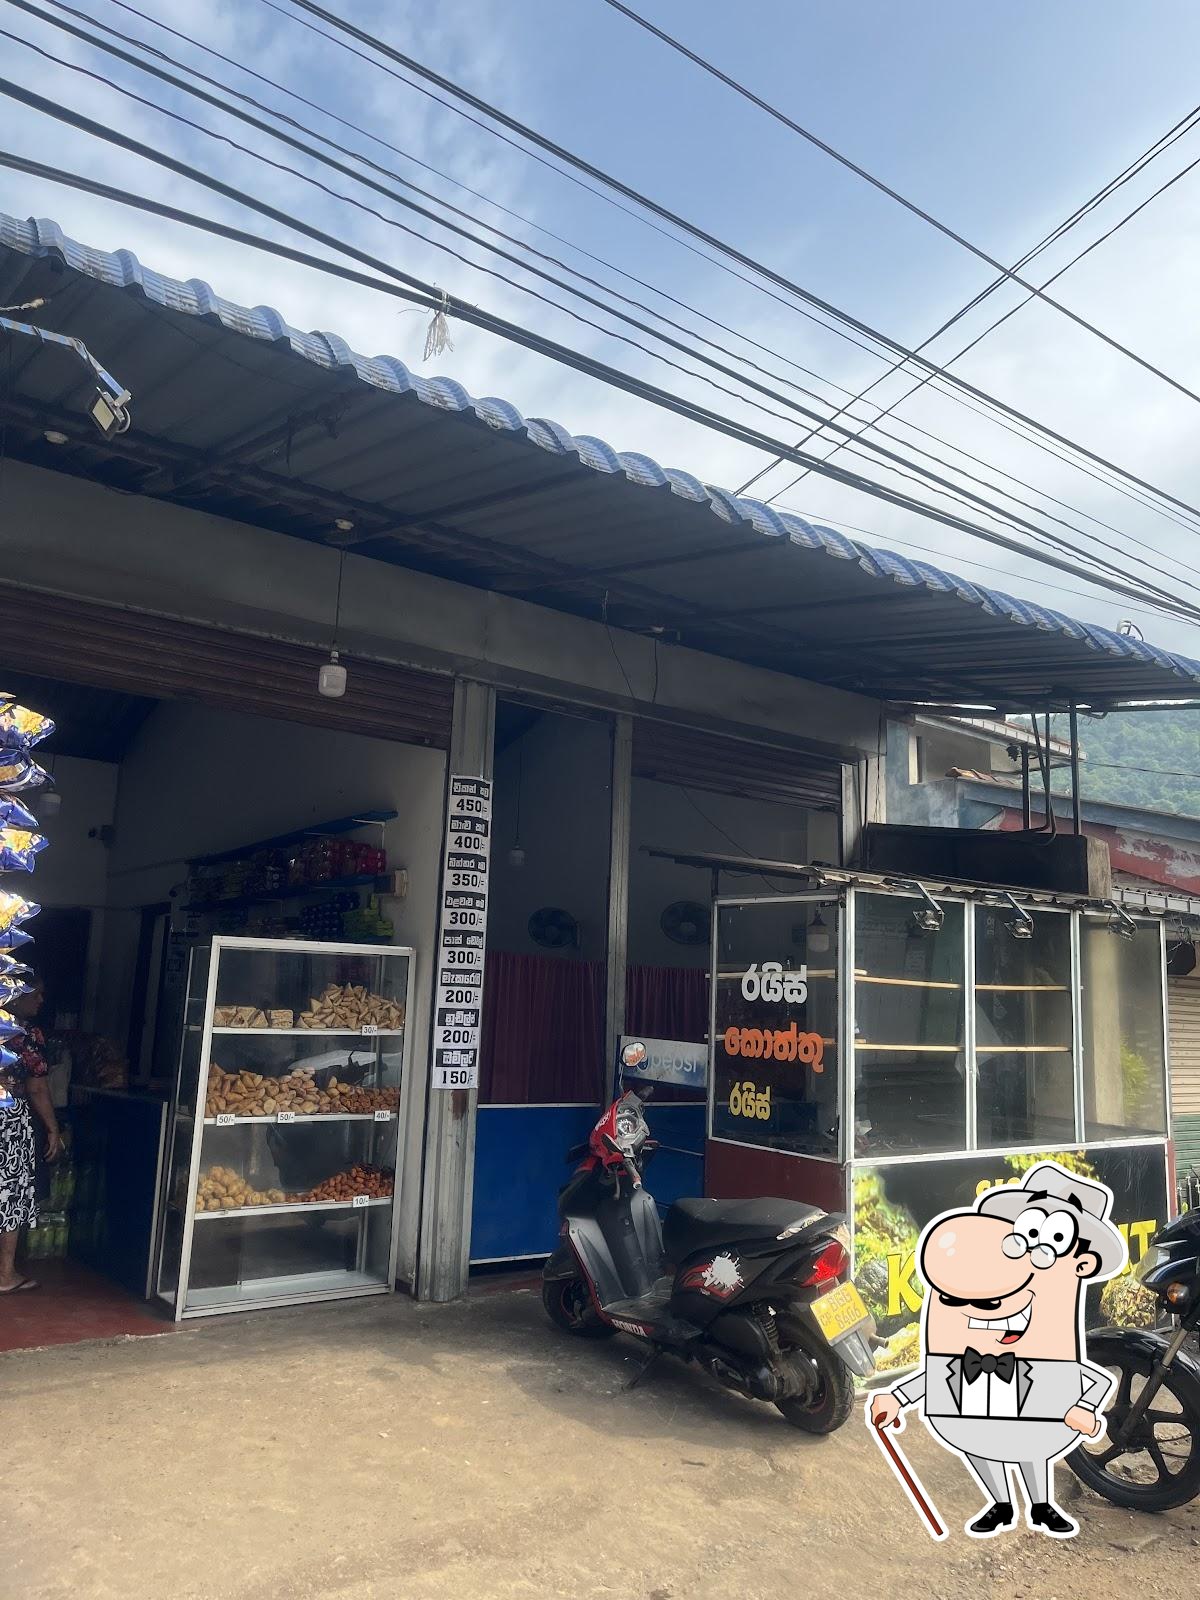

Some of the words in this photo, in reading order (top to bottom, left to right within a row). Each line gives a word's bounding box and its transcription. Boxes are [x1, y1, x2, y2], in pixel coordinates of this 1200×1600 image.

[452, 873, 485, 888] 350/=
[449, 912, 483, 926] 300/=
[447, 950, 481, 965] 300/=
[741, 961, 808, 1004] රයිස්
[445, 989, 479, 1004] 200/=
[442, 1029, 476, 1045] 200/=
[724, 1021, 825, 1073] කොත්තු
[651, 1053, 697, 1073] pepsi
[442, 1070, 473, 1085] 150/=
[729, 1081, 771, 1121] රයිස්
[611, 1318, 648, 1338] HONDA
